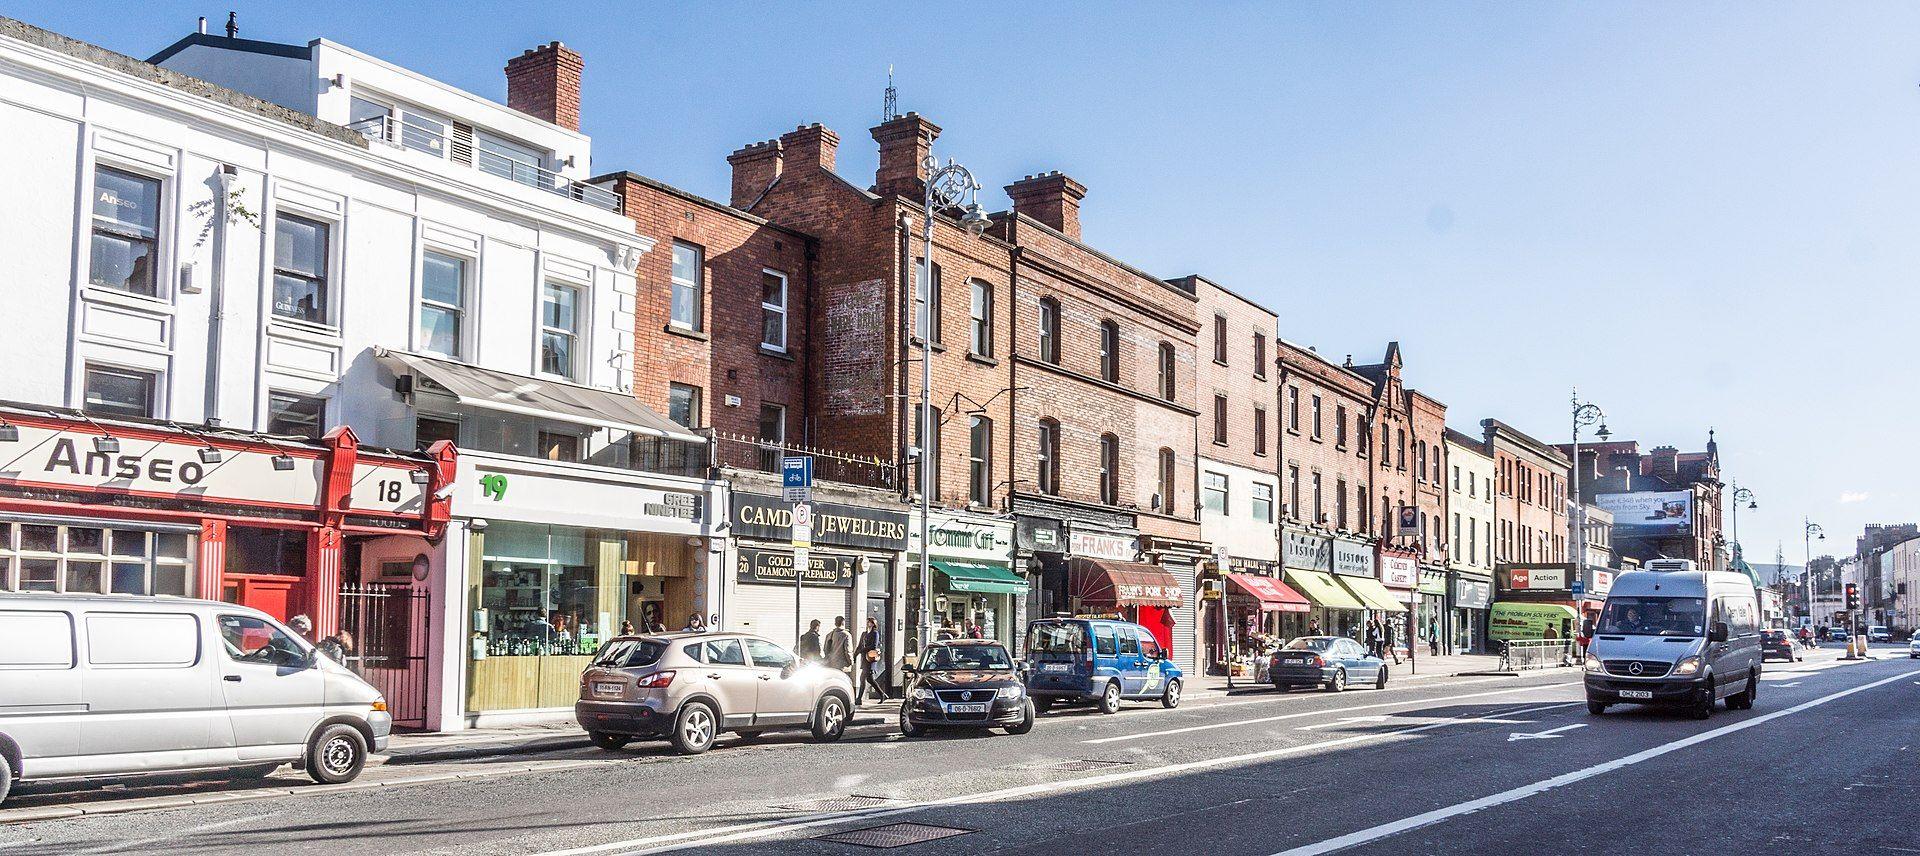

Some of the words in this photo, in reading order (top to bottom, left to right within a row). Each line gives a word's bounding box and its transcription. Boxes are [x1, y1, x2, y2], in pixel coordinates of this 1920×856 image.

[378, 479, 402, 503] 18
[479, 474, 508, 501] 19
[740, 505, 816, 531] CAMDN
[818, 514, 905, 540] JEWELLERS
[738, 562, 749, 573] 20
[768, 556, 792, 567] GOLD
[757, 566, 797, 577] DIAMOND
[805, 569, 836, 580] REPAIRS
[1512, 574, 1528, 583] Age
